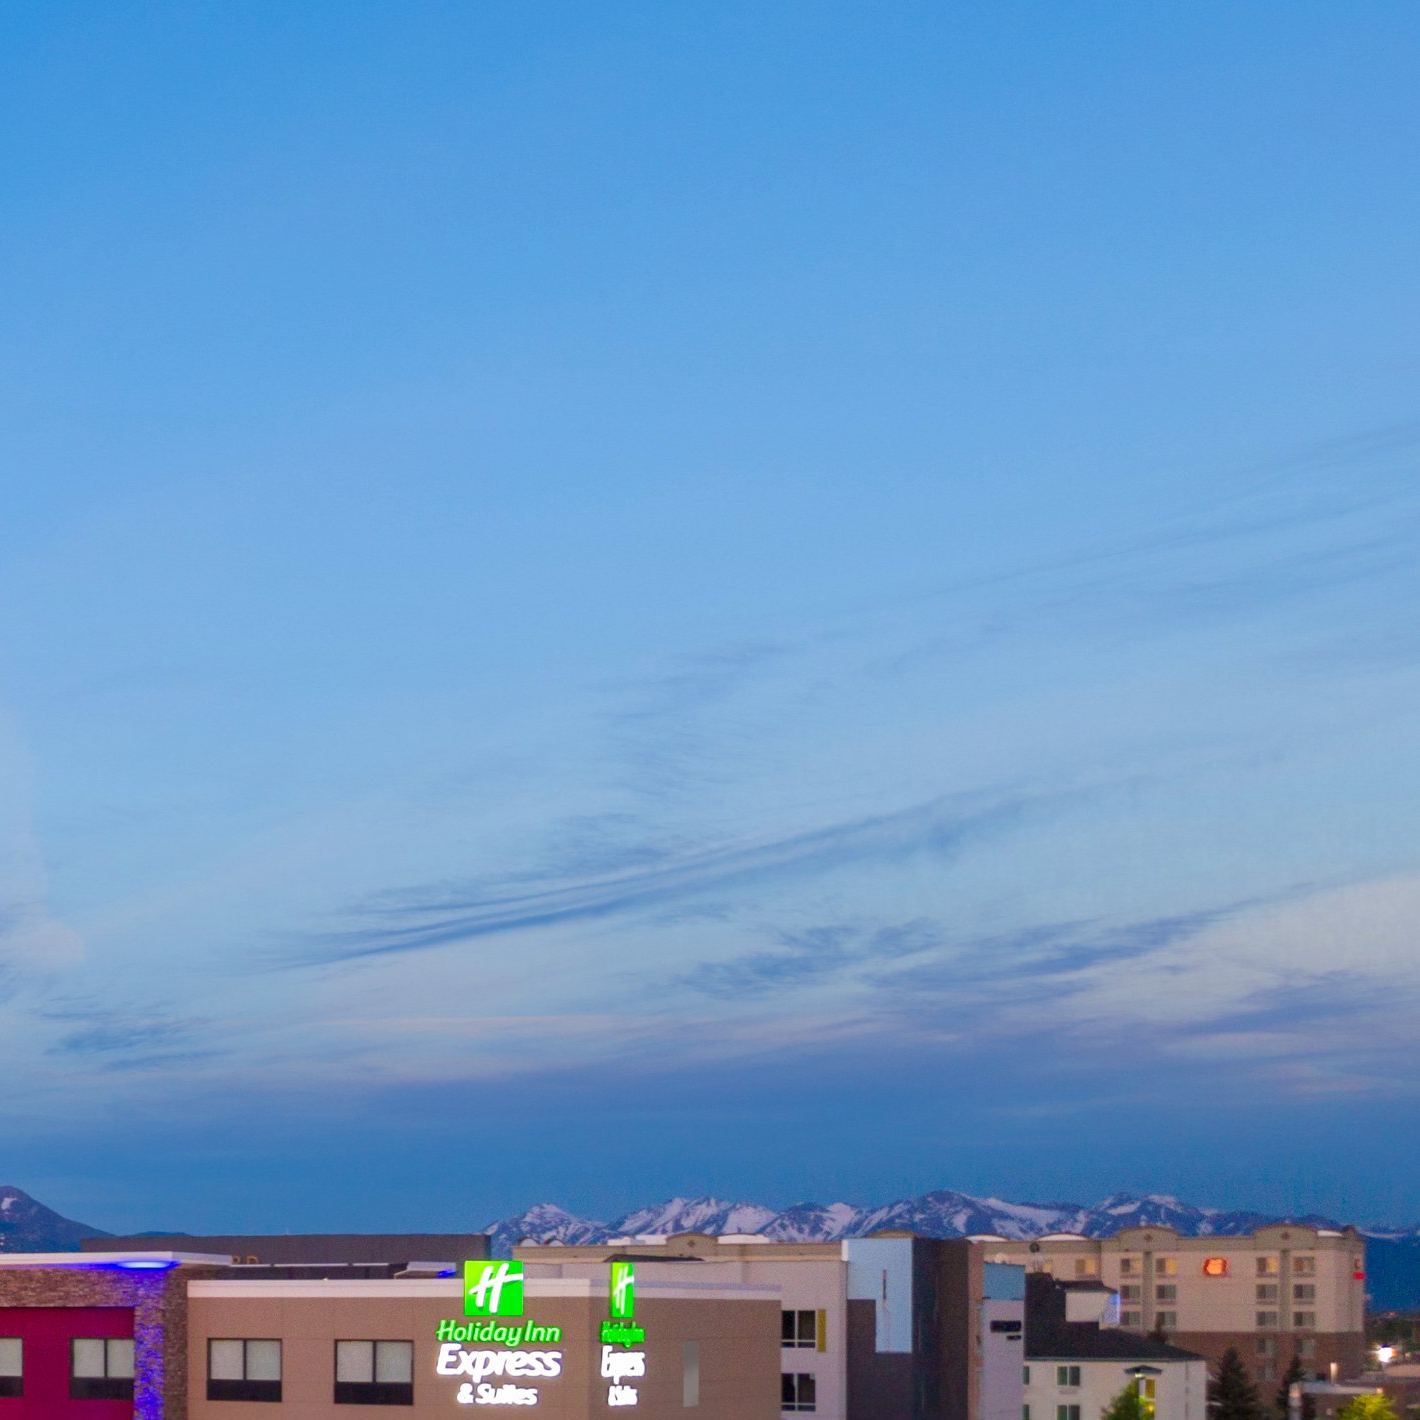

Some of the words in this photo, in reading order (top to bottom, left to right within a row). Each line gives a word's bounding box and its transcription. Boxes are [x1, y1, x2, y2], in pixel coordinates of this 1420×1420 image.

[436, 1319, 523, 1348] Holiday
[523, 1319, 561, 1342] Inn
[436, 1343, 562, 1383] Express
[457, 1383, 474, 1403] &
[475, 1383, 538, 1405] Suites
